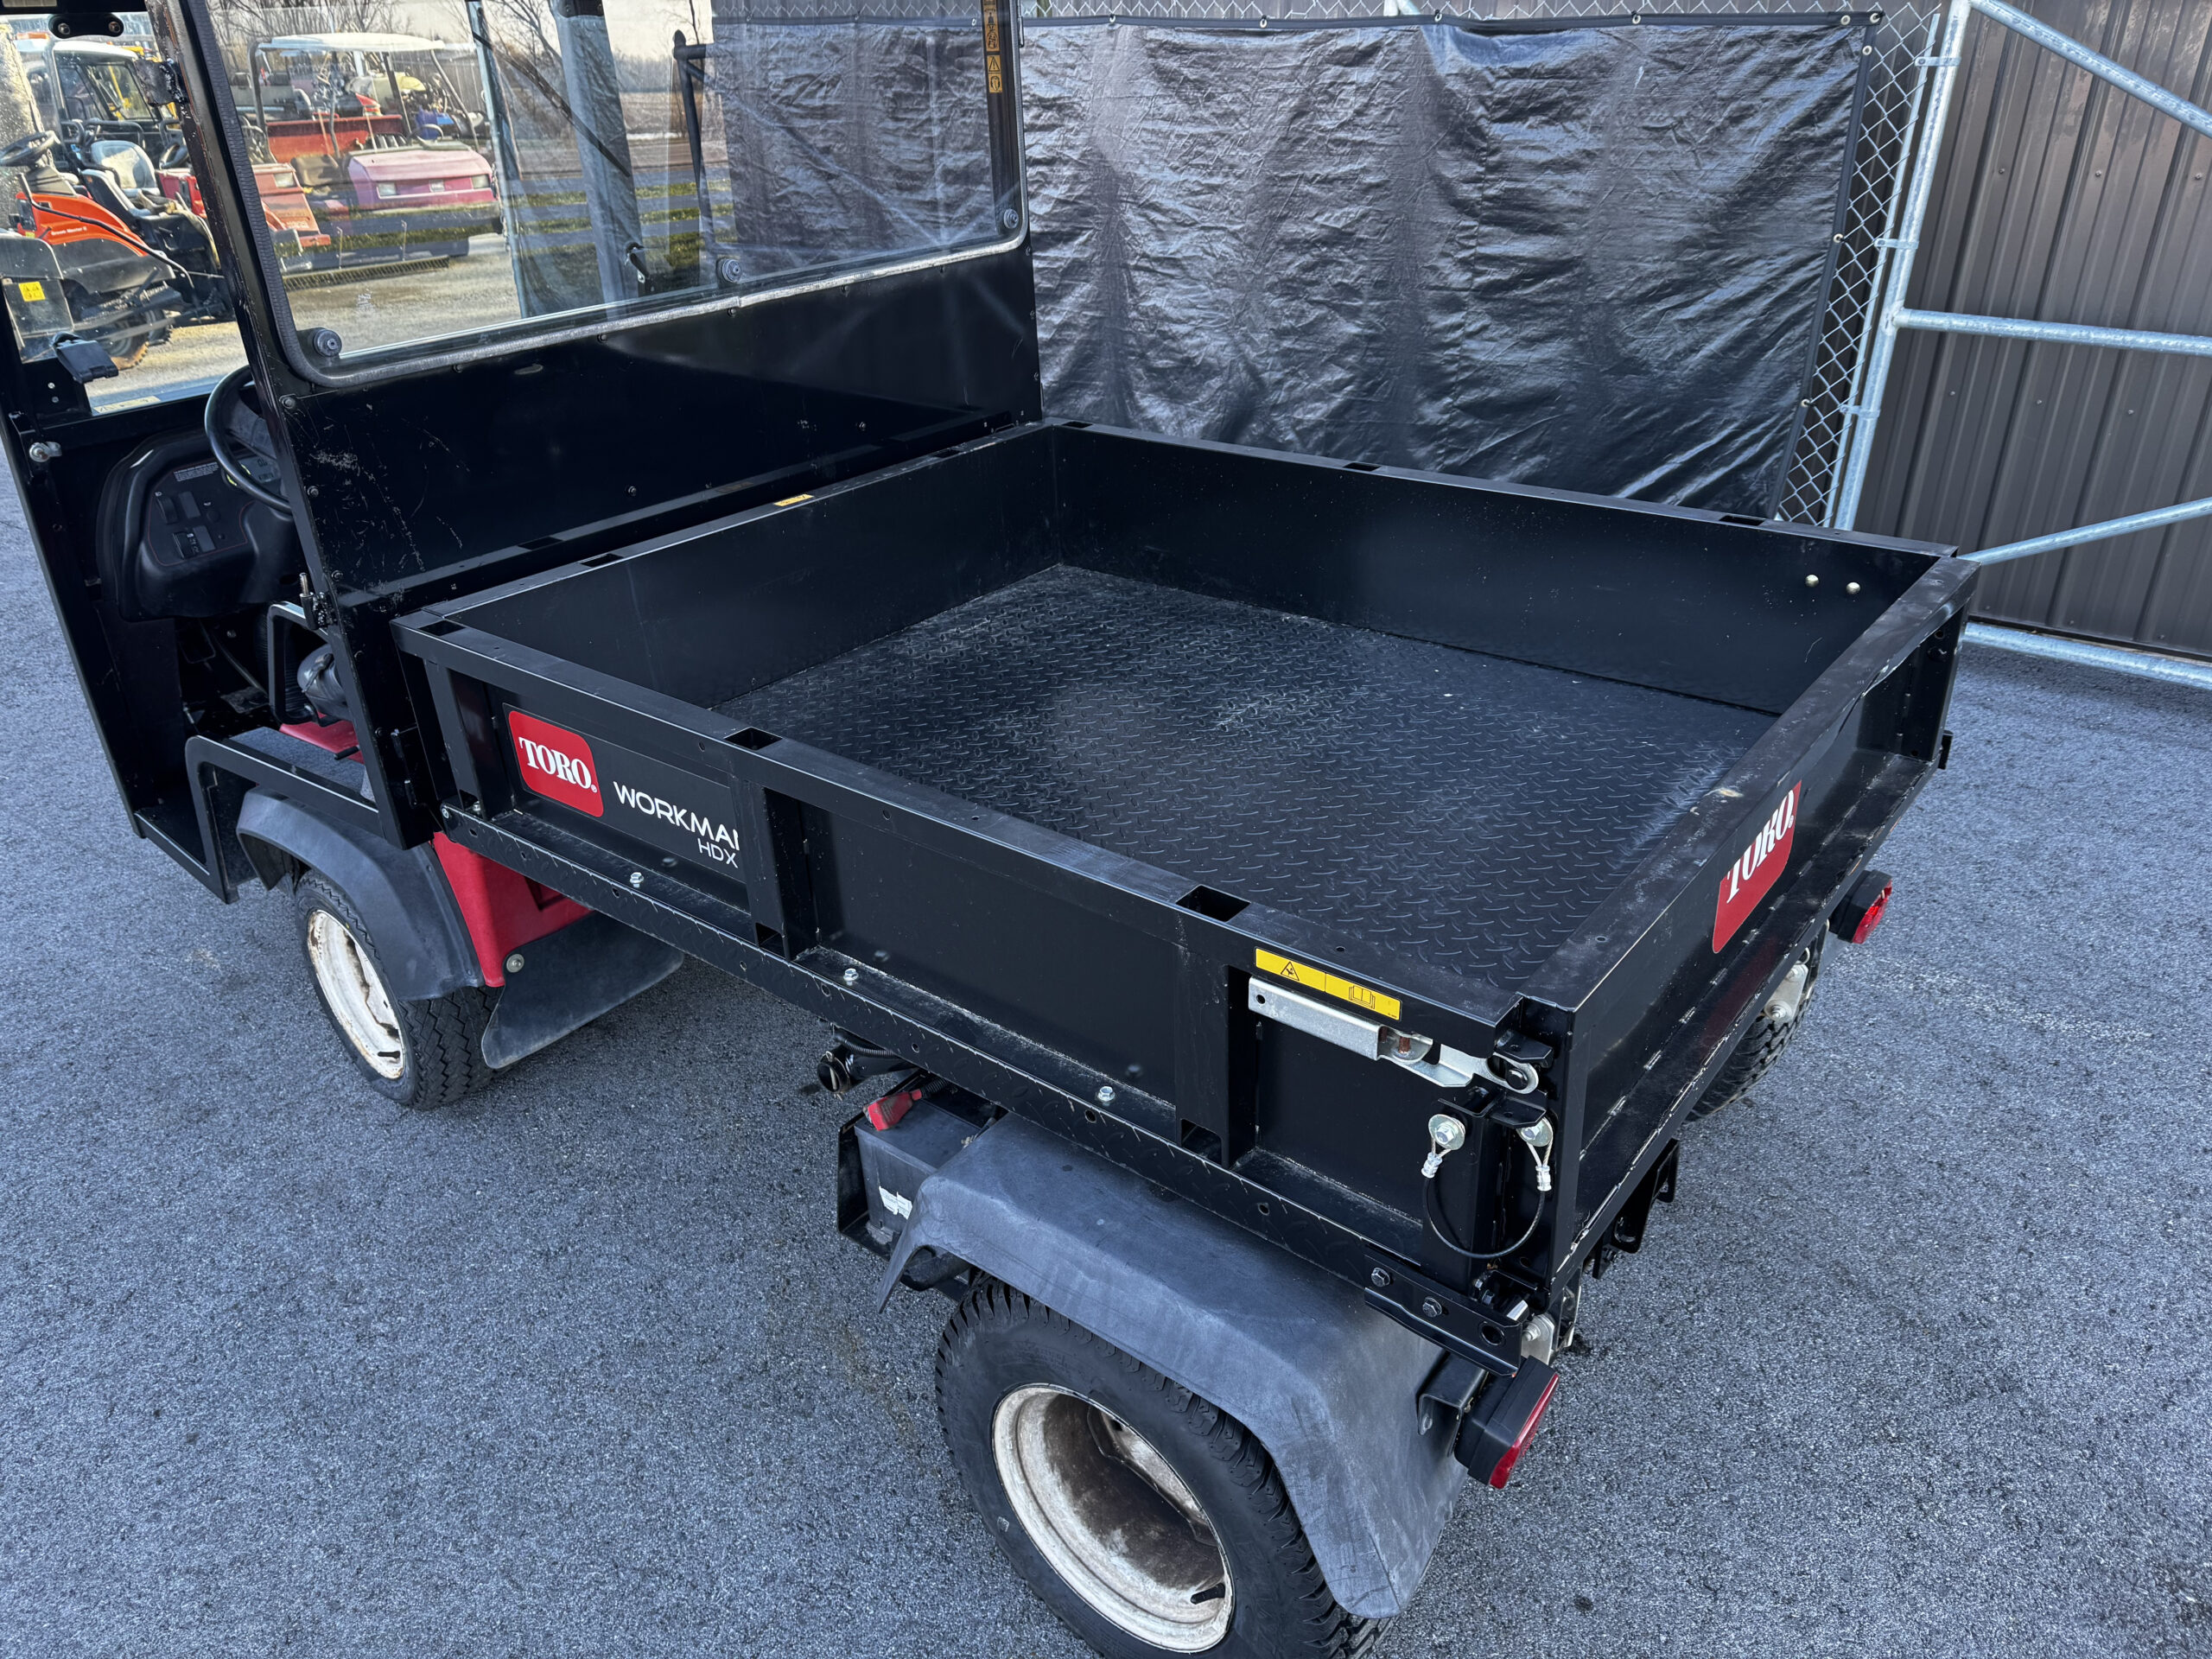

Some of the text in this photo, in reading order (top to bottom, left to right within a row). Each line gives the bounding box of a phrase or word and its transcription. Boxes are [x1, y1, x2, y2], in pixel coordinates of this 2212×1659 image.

[518, 736, 597, 793] TORO
[697, 838, 739, 868] HDX
[1726, 789, 1795, 904] TORO
